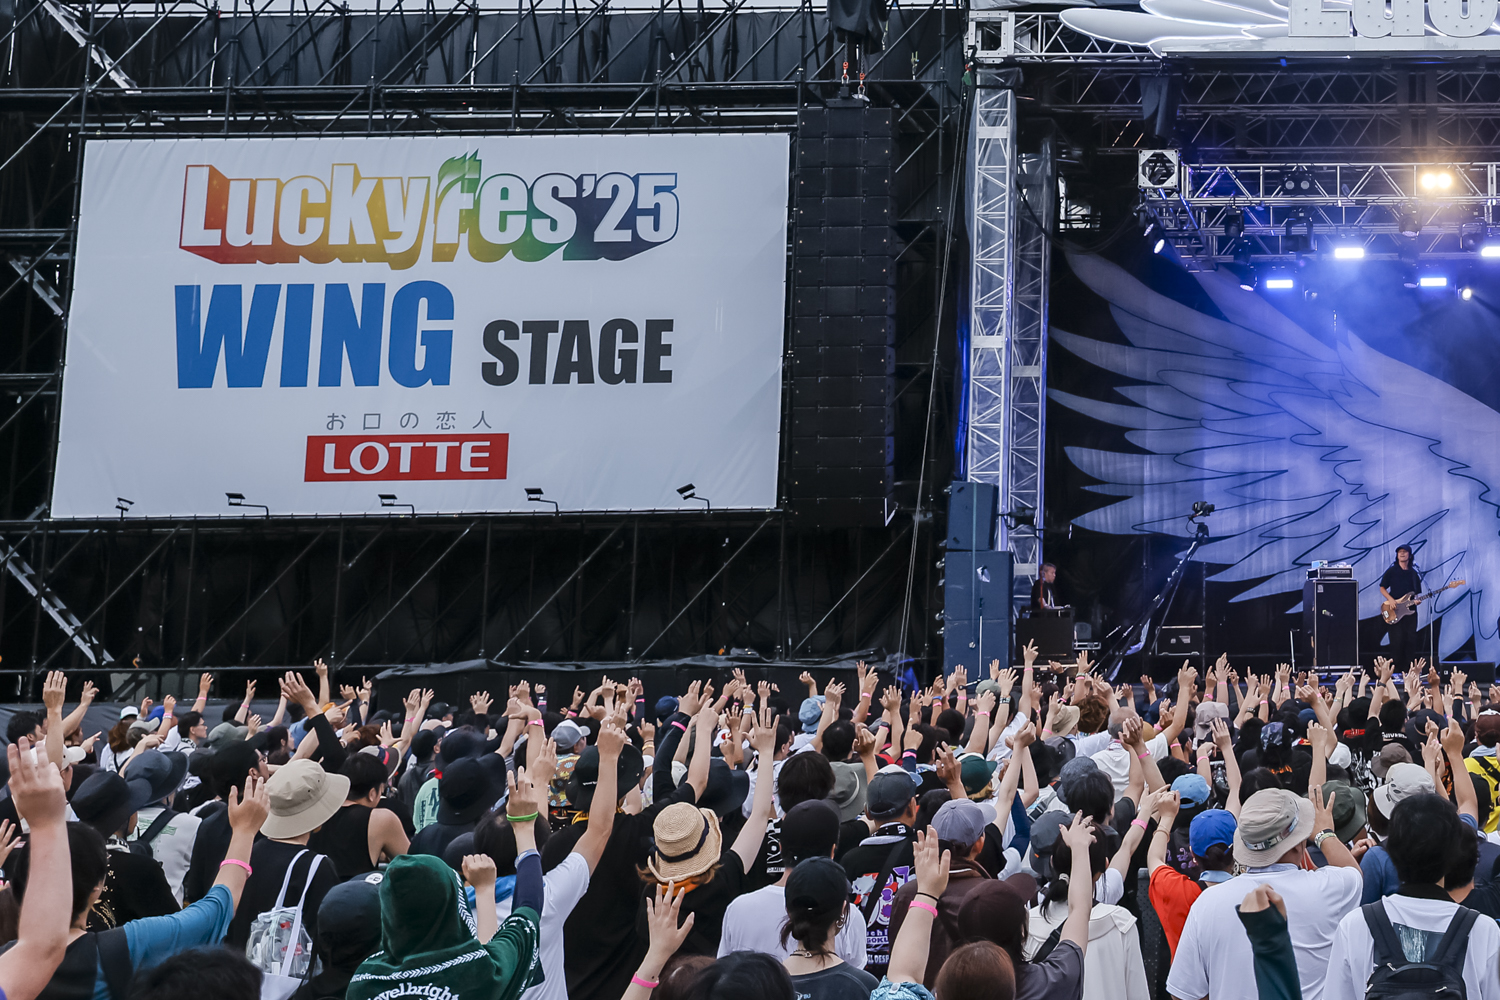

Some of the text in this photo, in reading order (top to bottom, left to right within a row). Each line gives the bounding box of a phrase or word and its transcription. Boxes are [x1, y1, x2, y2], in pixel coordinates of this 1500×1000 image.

[174, 280, 674, 389] WING STAGE
[326, 411, 492, 431] お口の恋人
[323, 441, 491, 475] LOTTE
